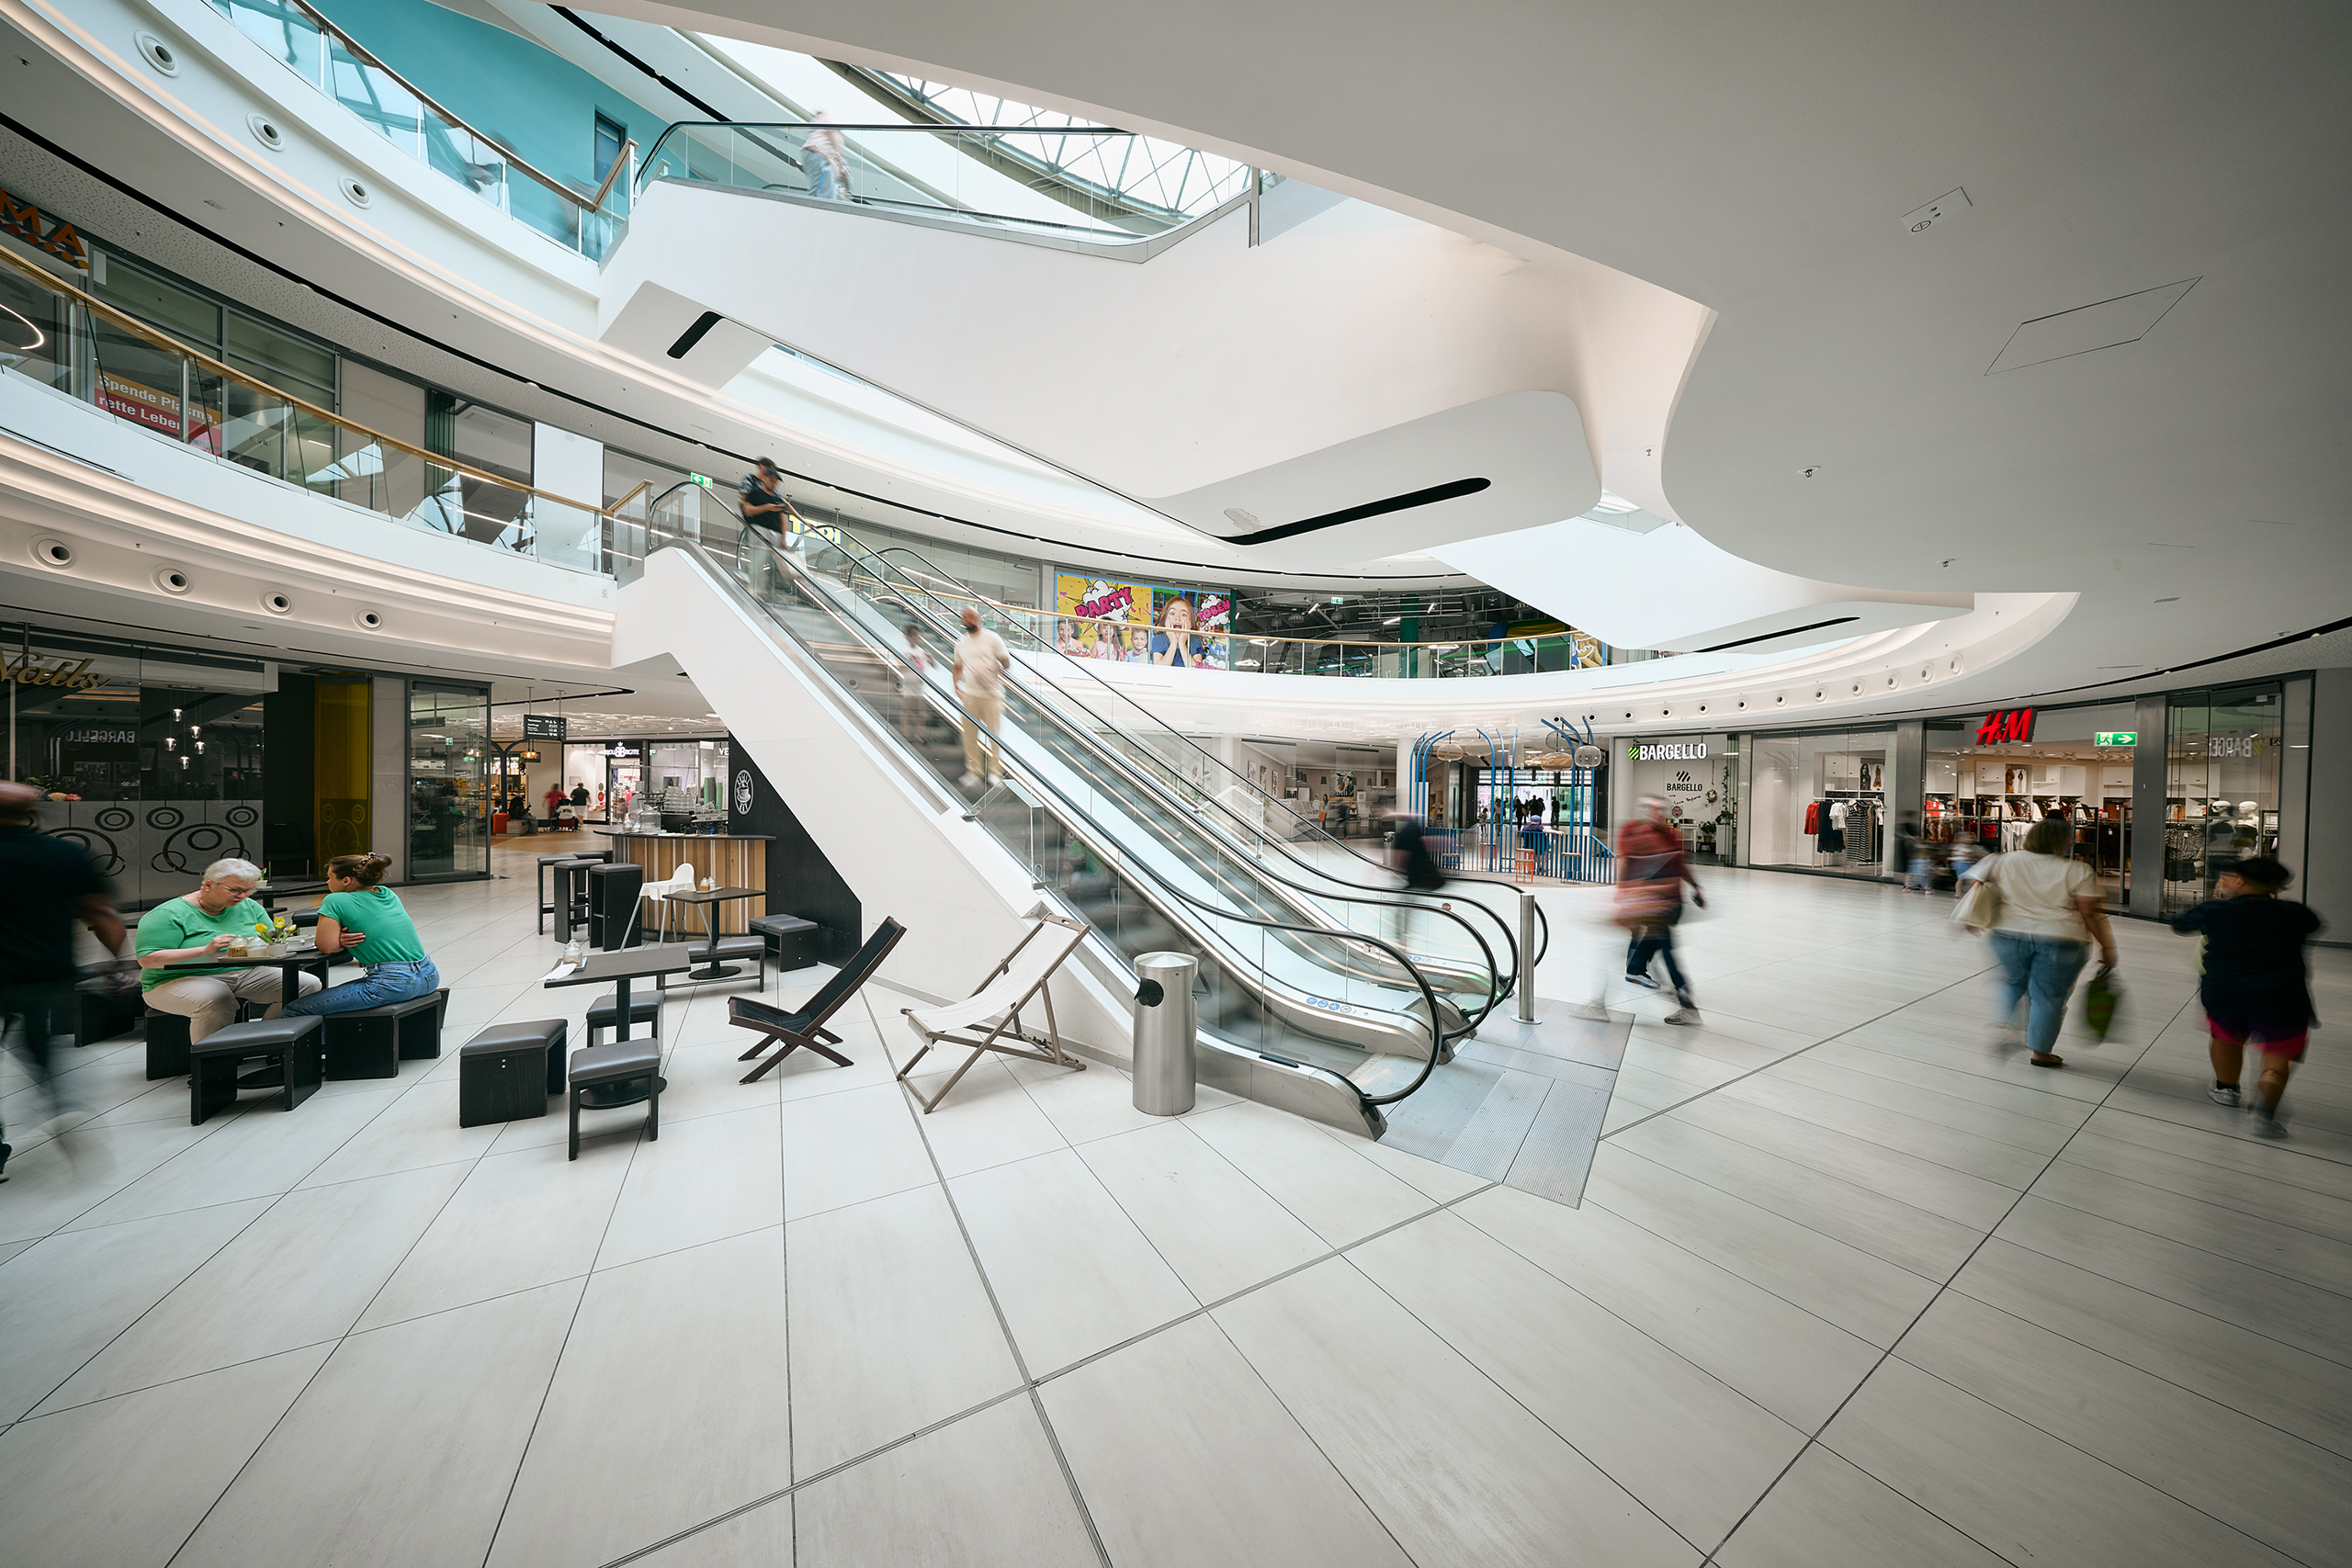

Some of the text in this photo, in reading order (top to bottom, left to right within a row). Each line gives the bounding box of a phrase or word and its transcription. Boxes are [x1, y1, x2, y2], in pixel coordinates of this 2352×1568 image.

[98, 375, 157, 403] Spende
[98, 396, 136, 415] rette
[1075, 587, 1134, 622] PARTY
[1196, 600, 1231, 622] TOBEN
[1975, 708, 2032, 745] H&M
[1639, 743, 1707, 761] BARGELLO
